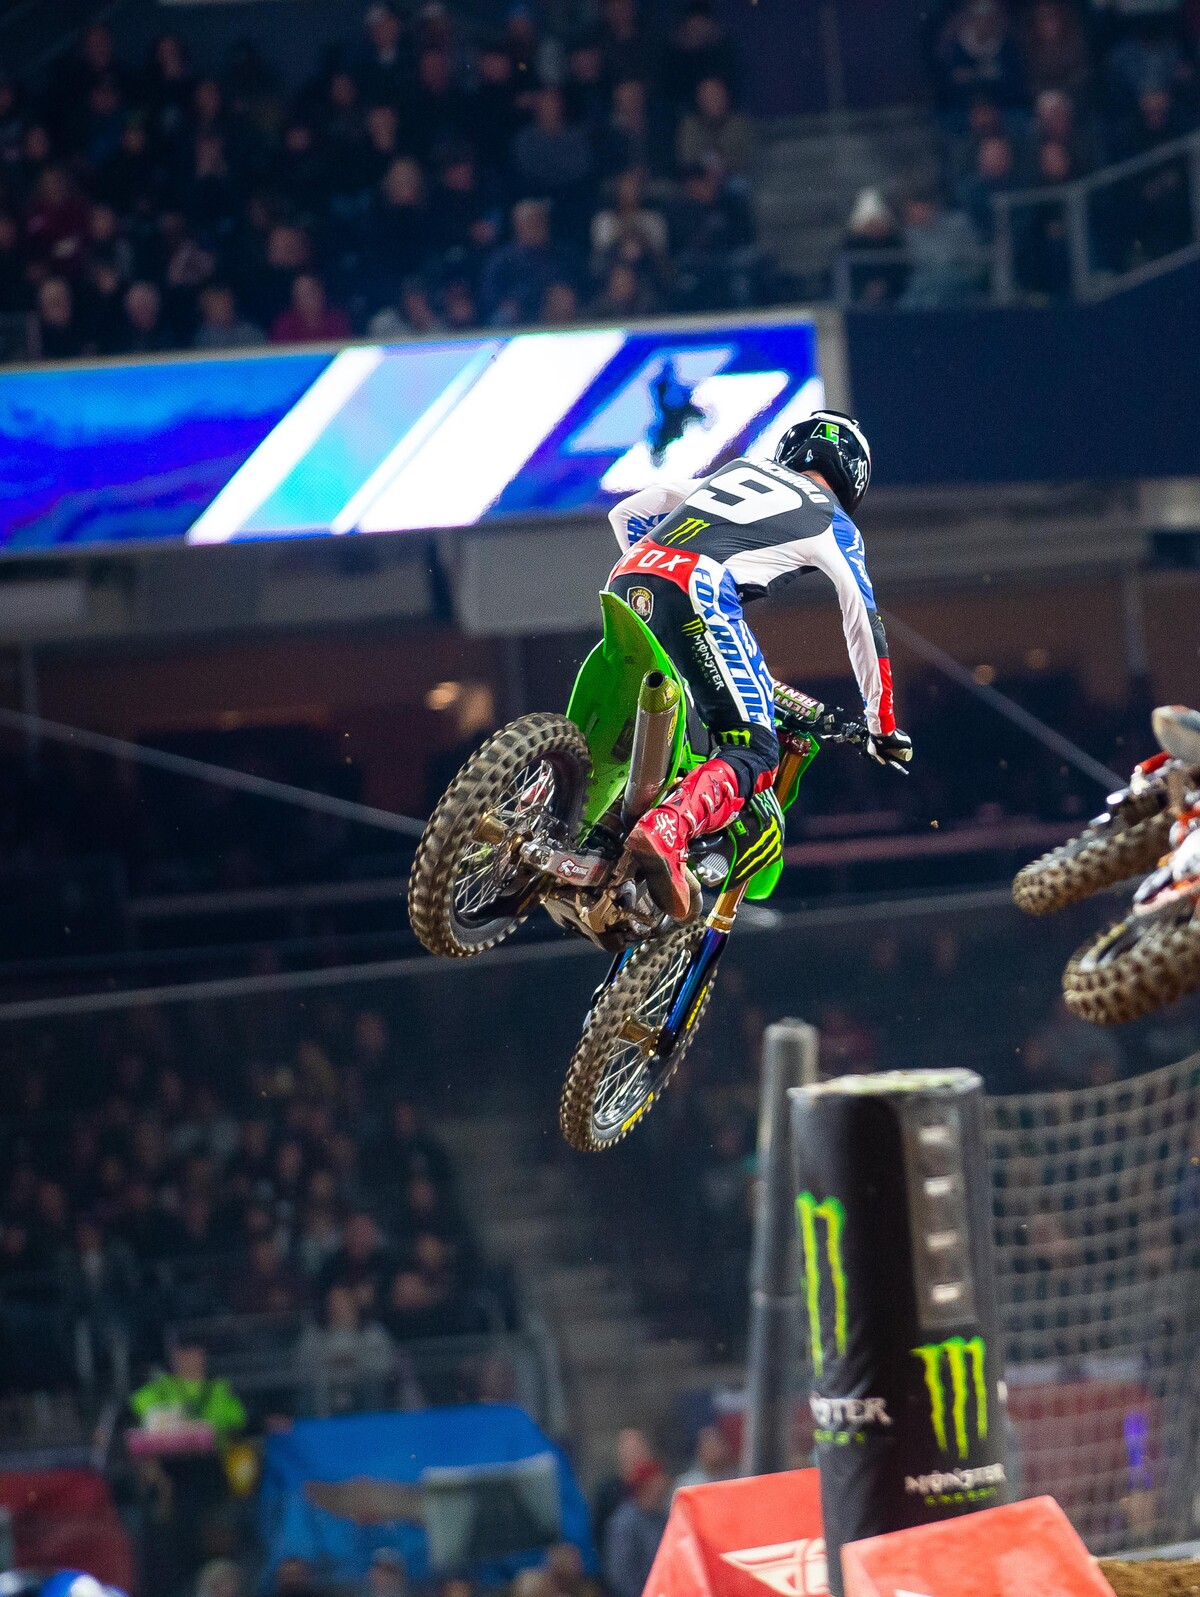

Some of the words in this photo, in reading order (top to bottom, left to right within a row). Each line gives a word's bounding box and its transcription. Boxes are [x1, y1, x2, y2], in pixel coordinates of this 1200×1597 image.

[684, 466, 803, 525] 9
[621, 547, 692, 572] FOX
[693, 633, 725, 692] MONSTER
[694, 567, 719, 621] FOX
[709, 624, 765, 723] RACING
